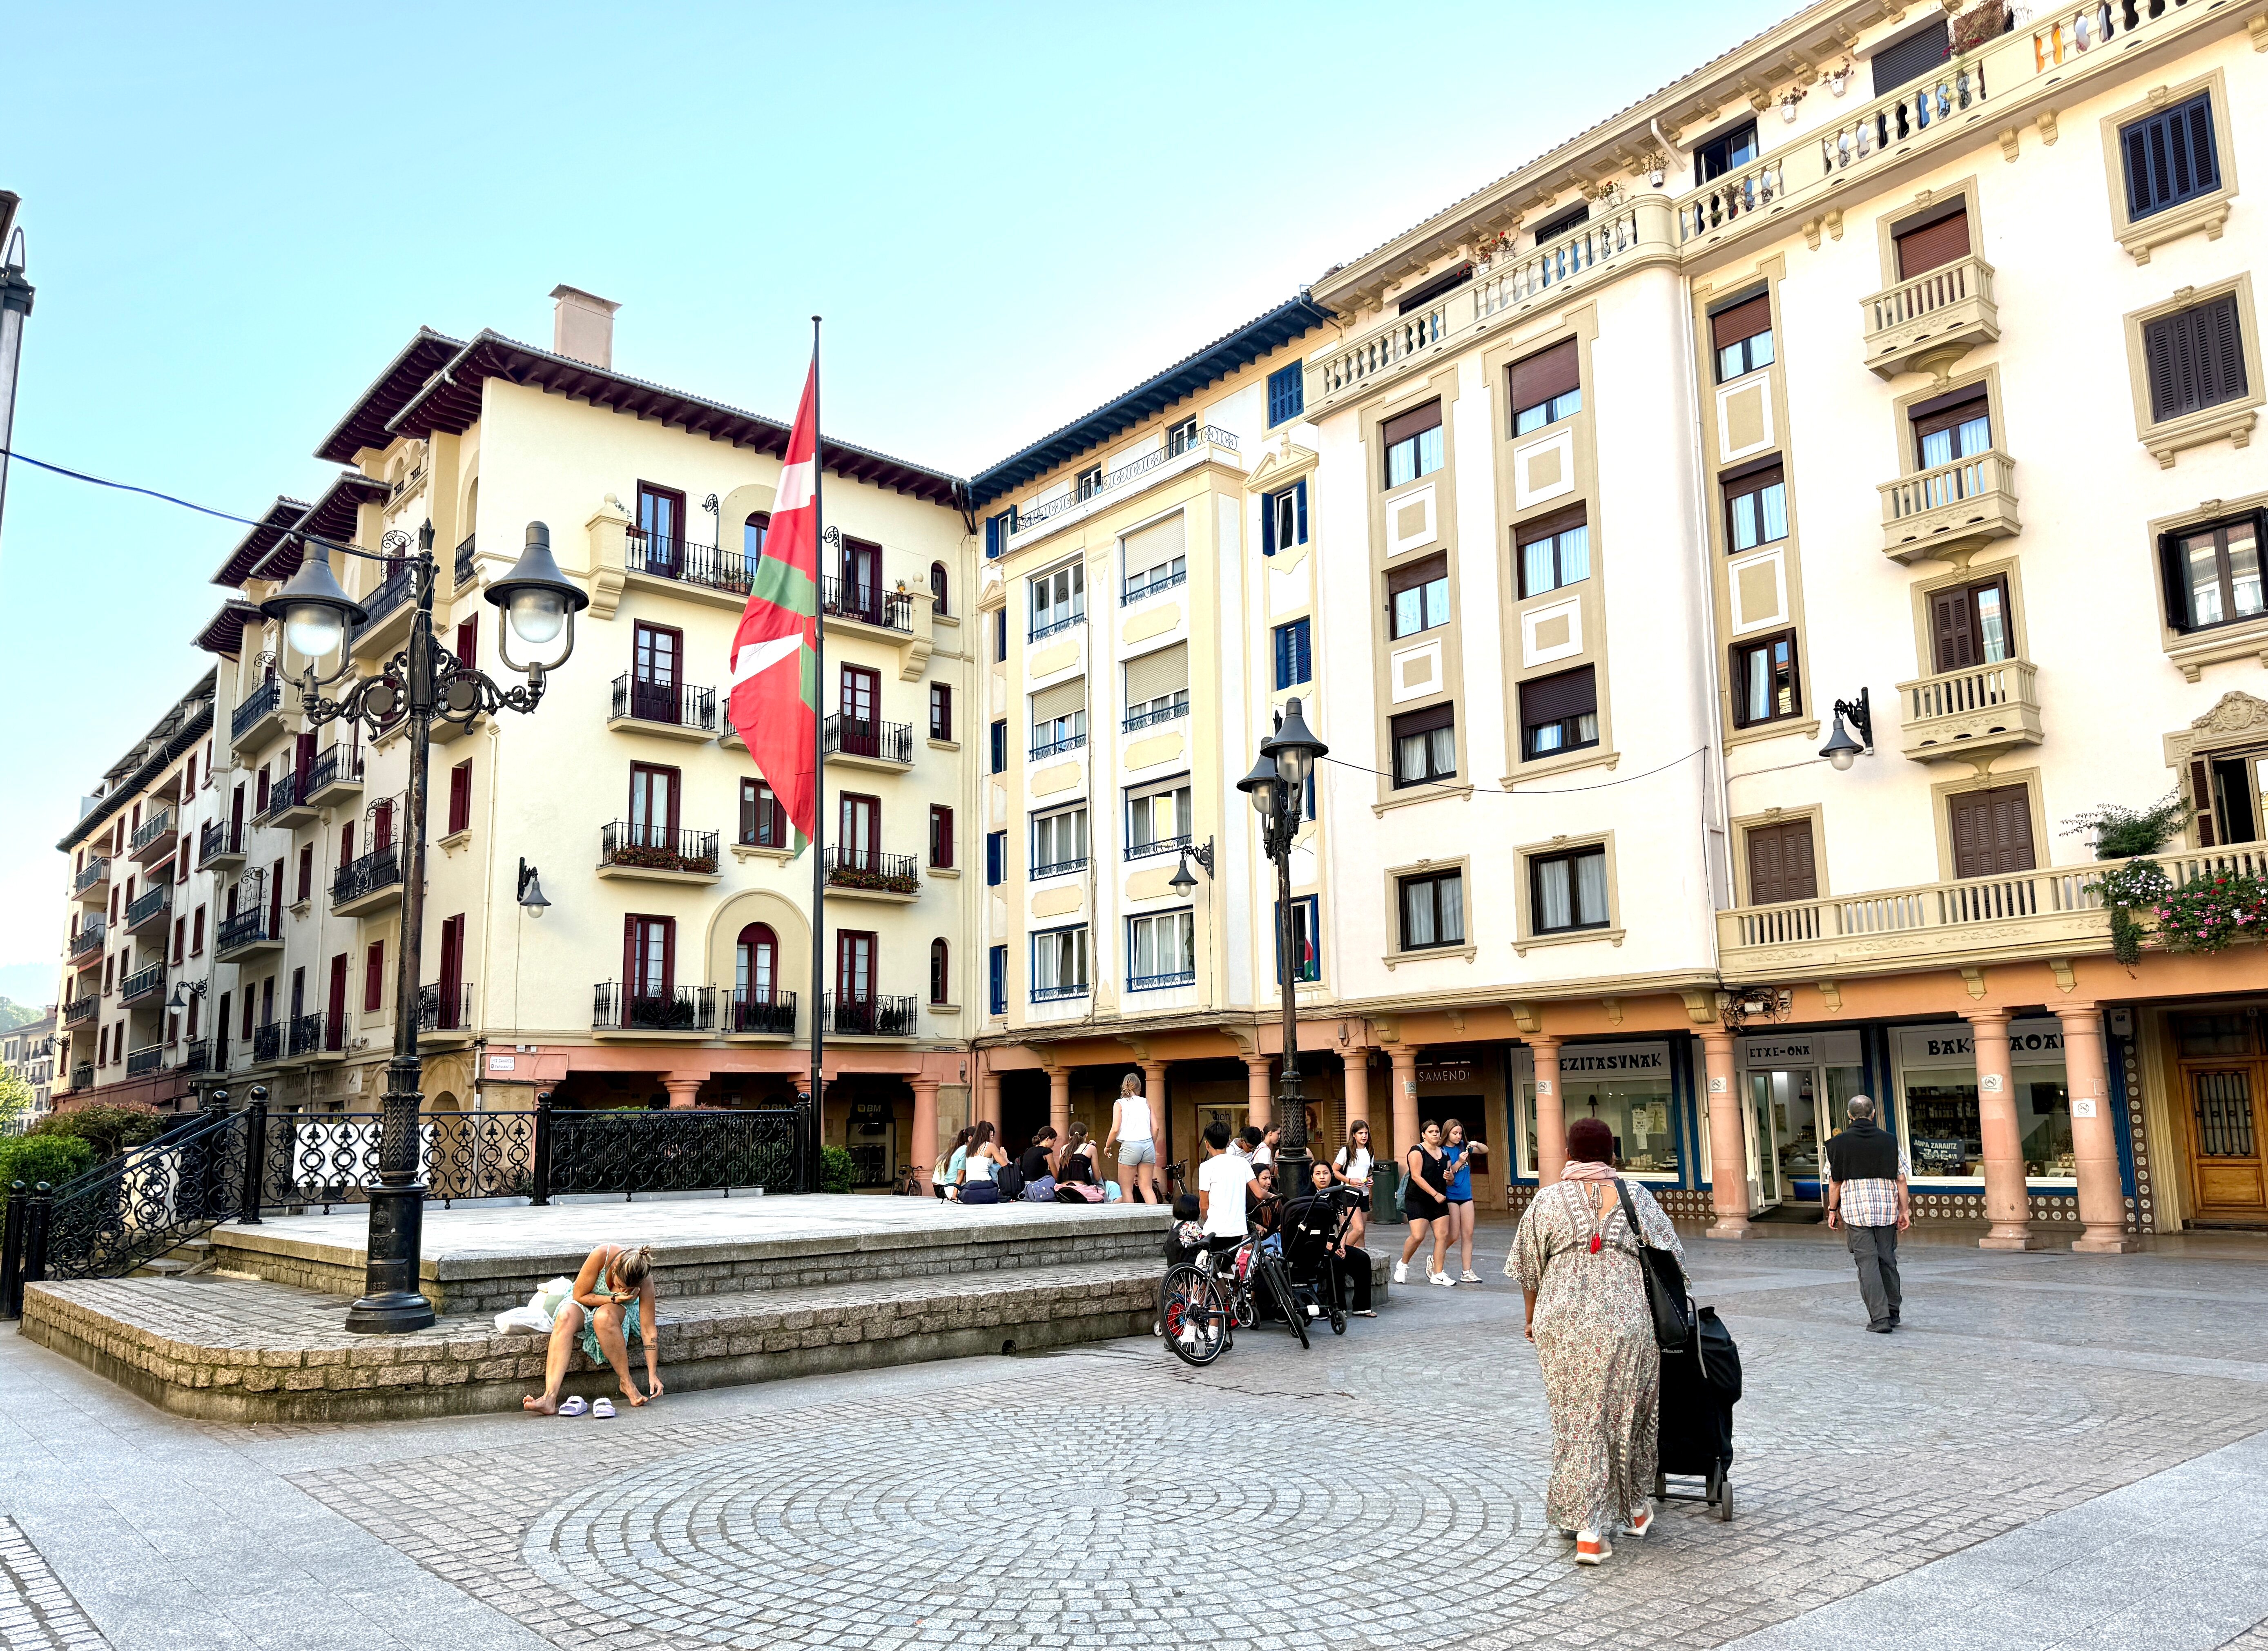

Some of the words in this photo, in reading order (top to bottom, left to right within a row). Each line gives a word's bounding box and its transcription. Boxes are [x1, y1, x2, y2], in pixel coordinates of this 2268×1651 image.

[1927, 1034, 2065, 1055] BAKAOA
[1750, 1046, 1810, 1058] ETXE-ONA
[1416, 1070, 1470, 1082] SAMENDI
[1913, 1139, 1930, 1148] AUPA
